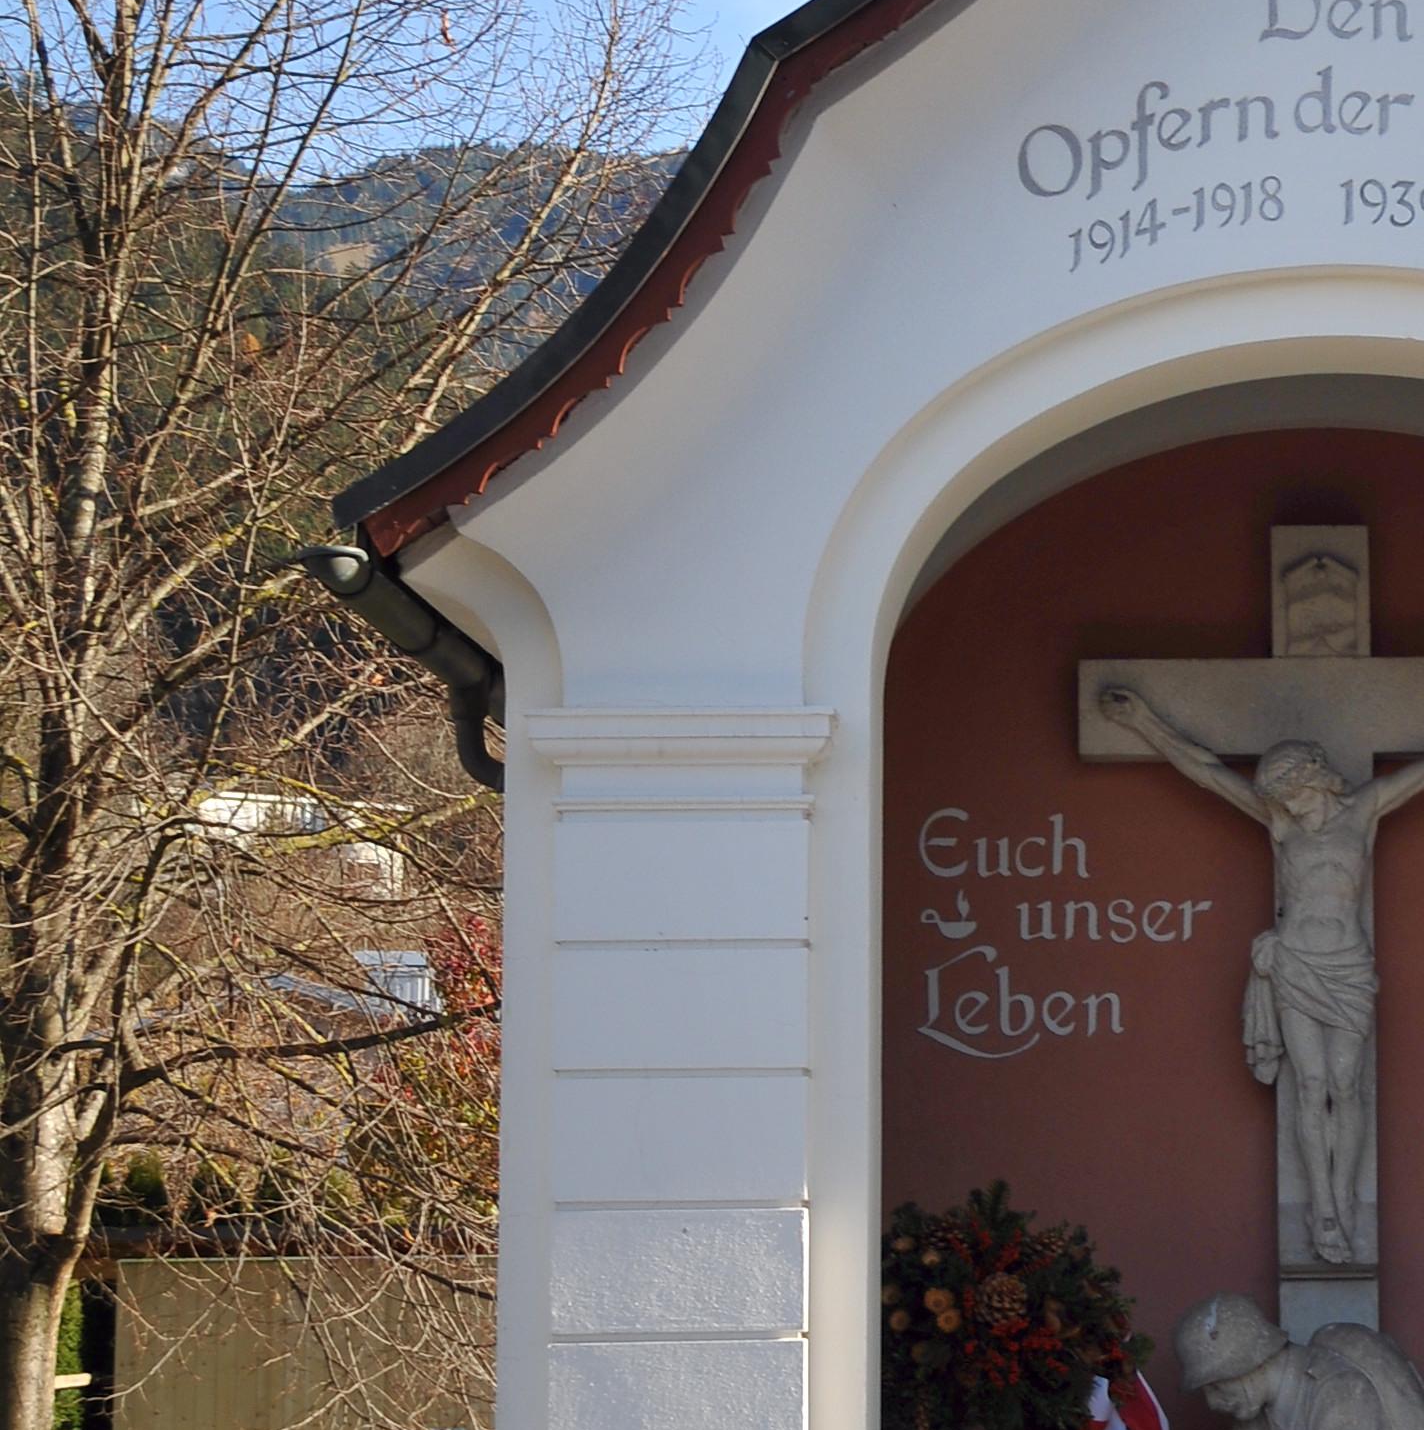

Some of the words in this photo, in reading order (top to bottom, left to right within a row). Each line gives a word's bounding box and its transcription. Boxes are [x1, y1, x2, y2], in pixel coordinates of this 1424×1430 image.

[1017, 80, 1281, 201] Opfern
[1294, 64, 1416, 137] der
[1068, 175, 1285, 274] 1914-1918
[918, 807, 1091, 879] Euch
[1015, 899, 1213, 944] unser
[917, 944, 1125, 1059] Leben
